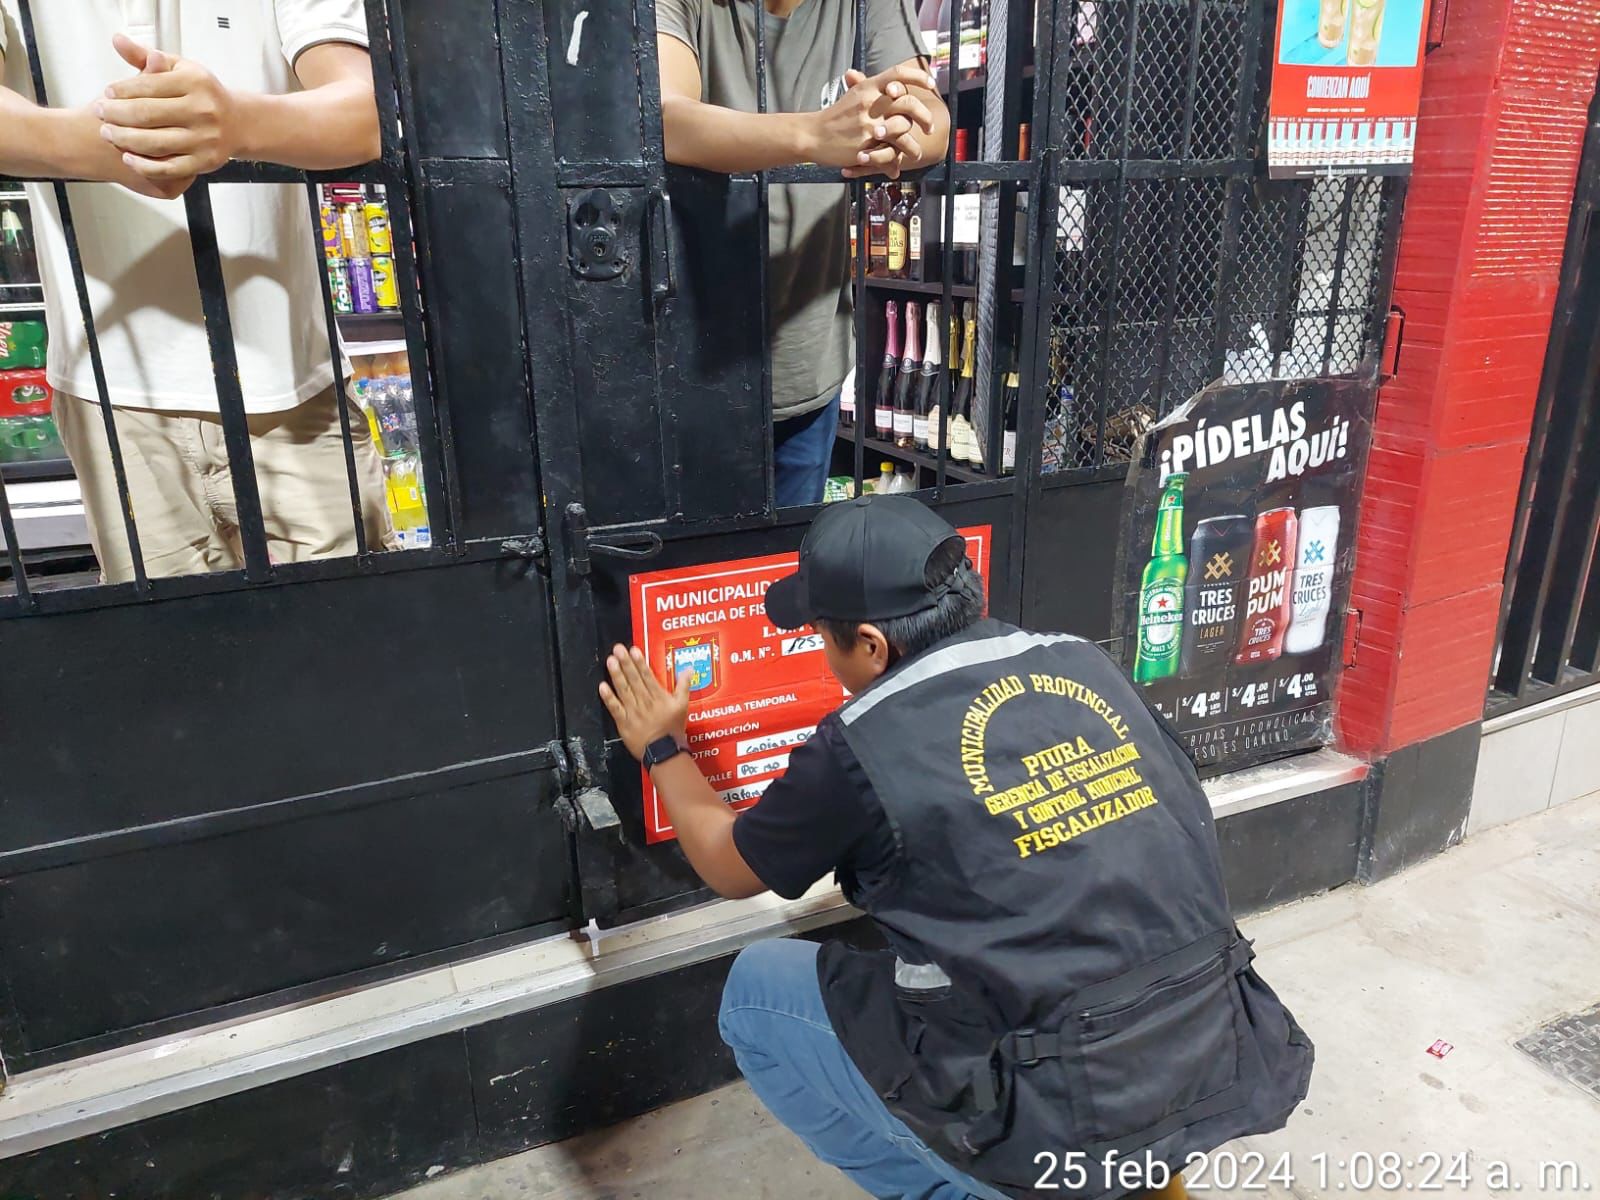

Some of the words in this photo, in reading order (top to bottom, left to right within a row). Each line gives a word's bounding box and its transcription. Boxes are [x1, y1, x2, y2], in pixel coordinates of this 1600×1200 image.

[1159, 401, 1306, 488] ¡PÍDELAS
[1264, 415, 1349, 483] AQUÍ!
[656, 579, 779, 612] MUNICIPALID
[1249, 566, 1287, 599] PUM
[1292, 585, 1327, 605] CRUCES
[1300, 572, 1324, 588] TRES
[1200, 588, 1232, 607] TRES
[1247, 586, 1284, 619] PUM
[662, 611, 726, 631] GERENCIA
[729, 607, 745, 619] DE
[1191, 605, 1236, 625] CRUCES
[1200, 625, 1225, 639] LAGER
[688, 703, 742, 722] CLAUSURA
[744, 693, 797, 711] TEMPORAL
[690, 722, 760, 743] DEMOLICIÓN
[961, 675, 1025, 795] MUNICIPALIDAD
[1029, 674, 1129, 740] PROVINCIAL
[1185, 728, 1225, 747] BIDAS
[1021, 736, 1095, 776] PIURA
[984, 779, 1049, 815] GERENCIA
[1045, 770, 1069, 791] DE
[1013, 811, 1028, 830] Y
[1028, 788, 1087, 824] CONTROL
[1084, 767, 1142, 800] MUNICIPAL
[1013, 786, 1158, 858] FISCALIZADOR
